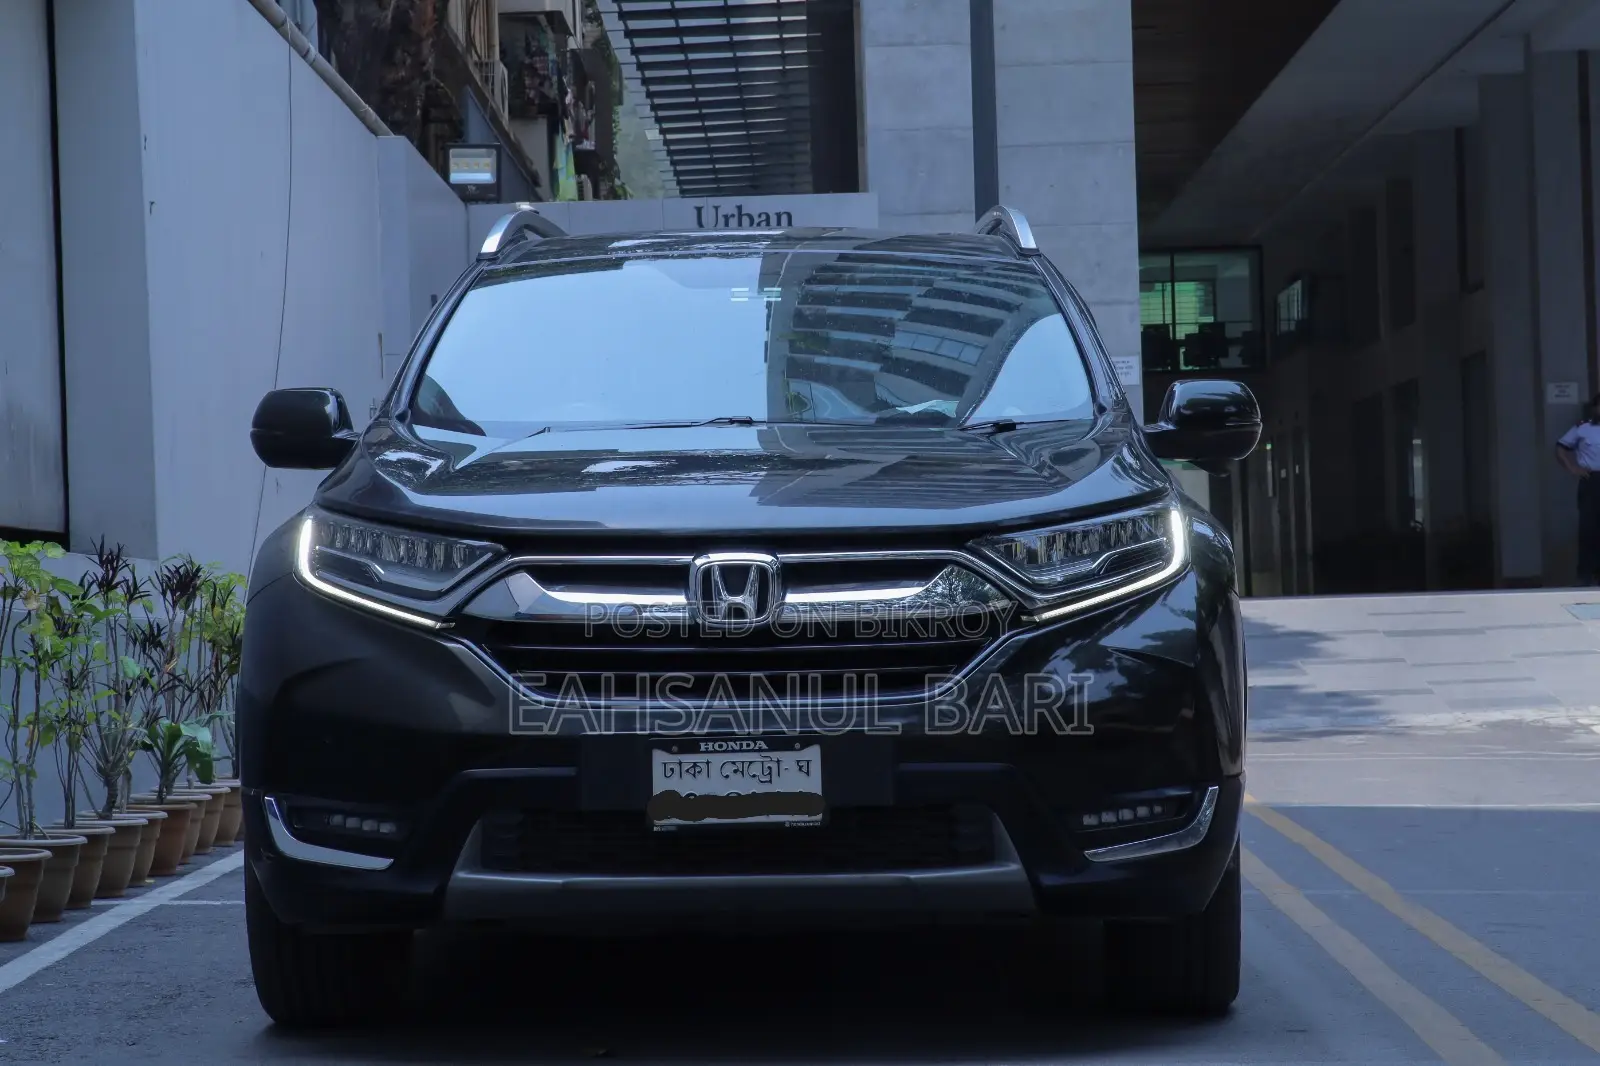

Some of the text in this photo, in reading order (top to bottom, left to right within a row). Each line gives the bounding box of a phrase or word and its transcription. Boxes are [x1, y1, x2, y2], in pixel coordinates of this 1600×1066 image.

[694, 204, 793, 228] Urban
[699, 740, 769, 752] HONDA
[661, 758, 713, 779] ঢাকা
